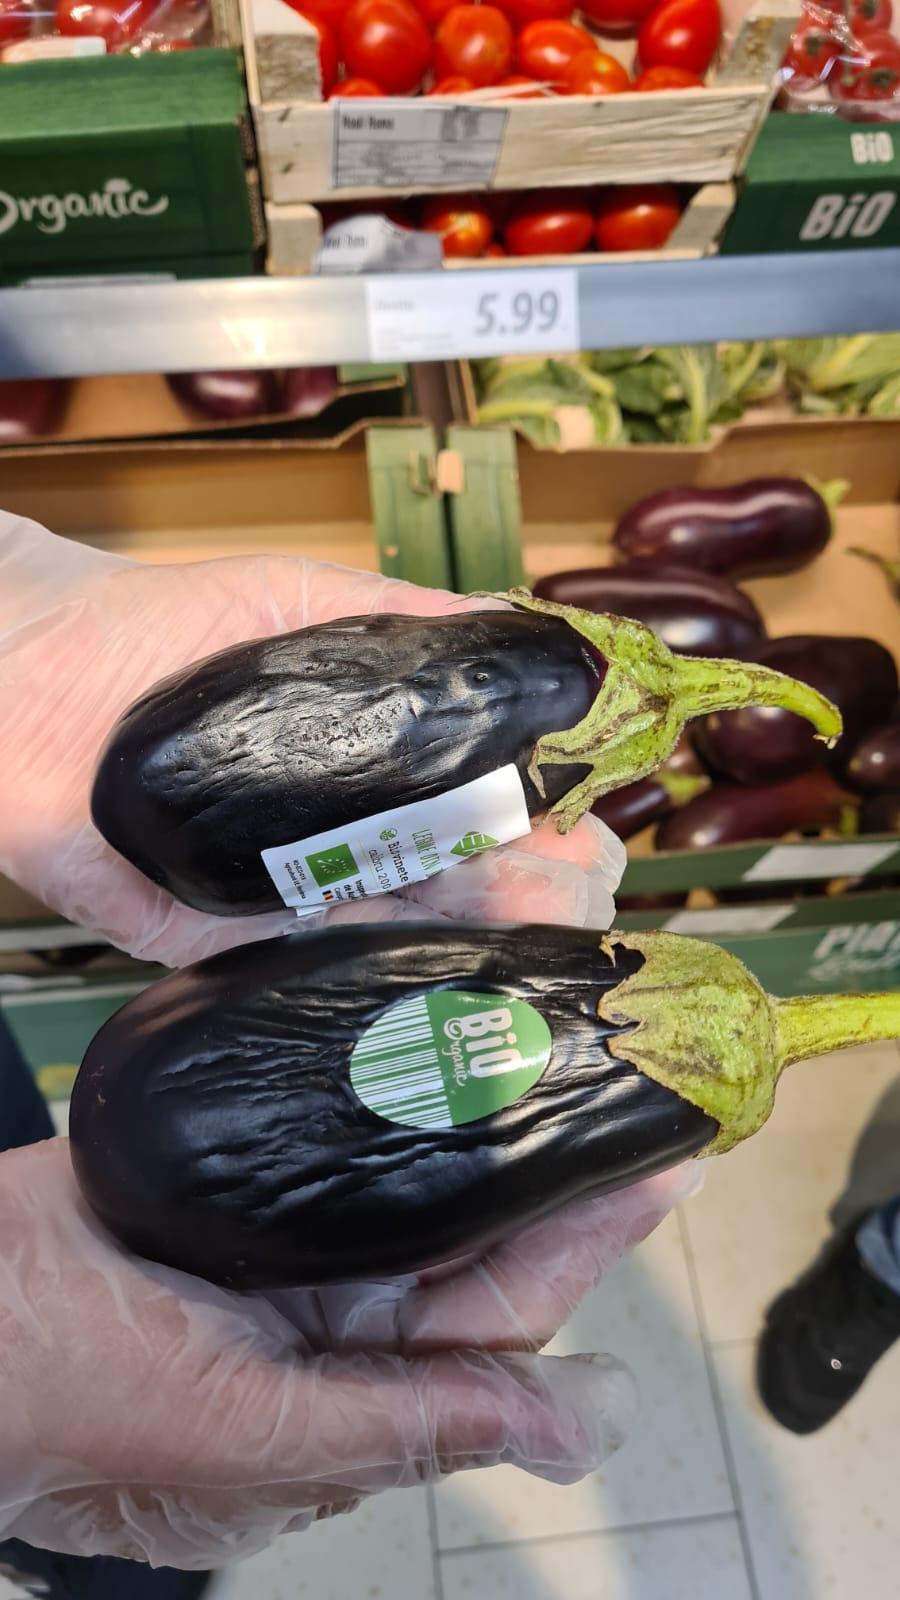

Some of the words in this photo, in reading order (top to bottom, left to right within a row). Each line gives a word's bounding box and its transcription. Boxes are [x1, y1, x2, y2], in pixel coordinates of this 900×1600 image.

[475, 289, 561, 336] 5.99
[377, 872, 392, 890] 200
[442, 1017, 469, 1087] Organic
